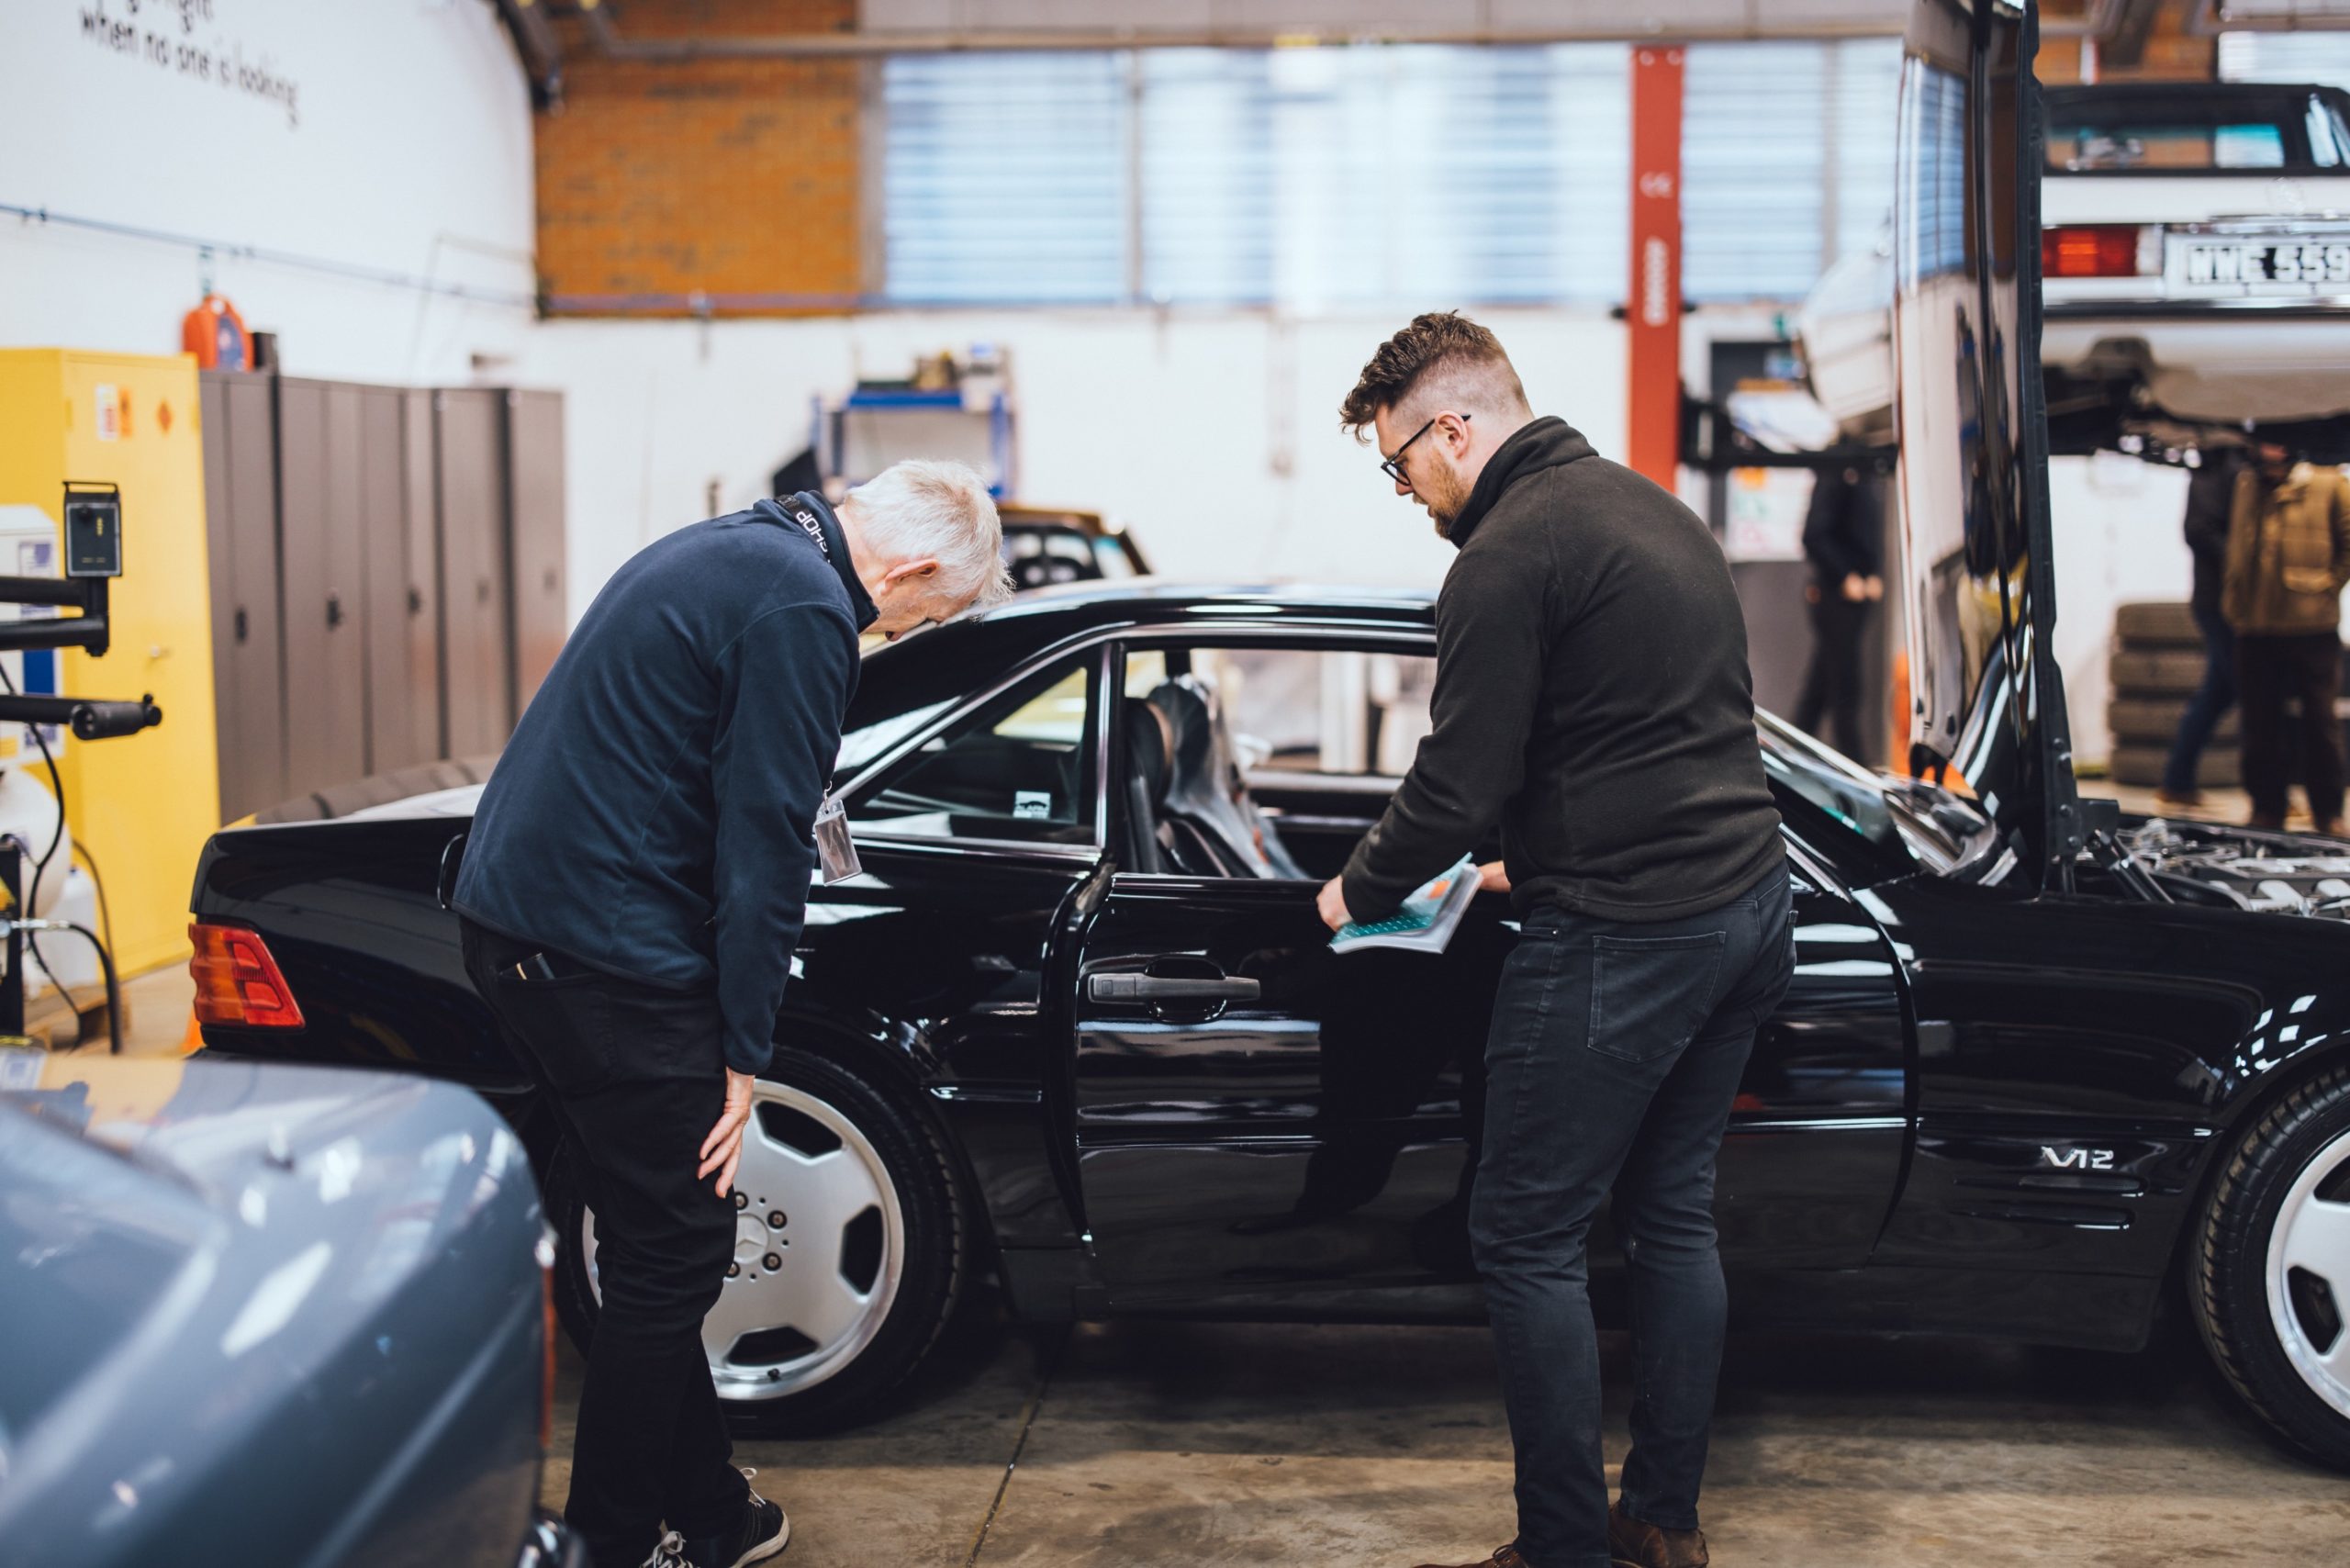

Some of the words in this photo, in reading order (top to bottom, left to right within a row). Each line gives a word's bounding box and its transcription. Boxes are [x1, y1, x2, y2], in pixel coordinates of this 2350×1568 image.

[79, 2, 139, 53] when
[143, 31, 169, 66] no
[175, 43, 209, 78] one
[2041, 1146, 2114, 1170] V12
